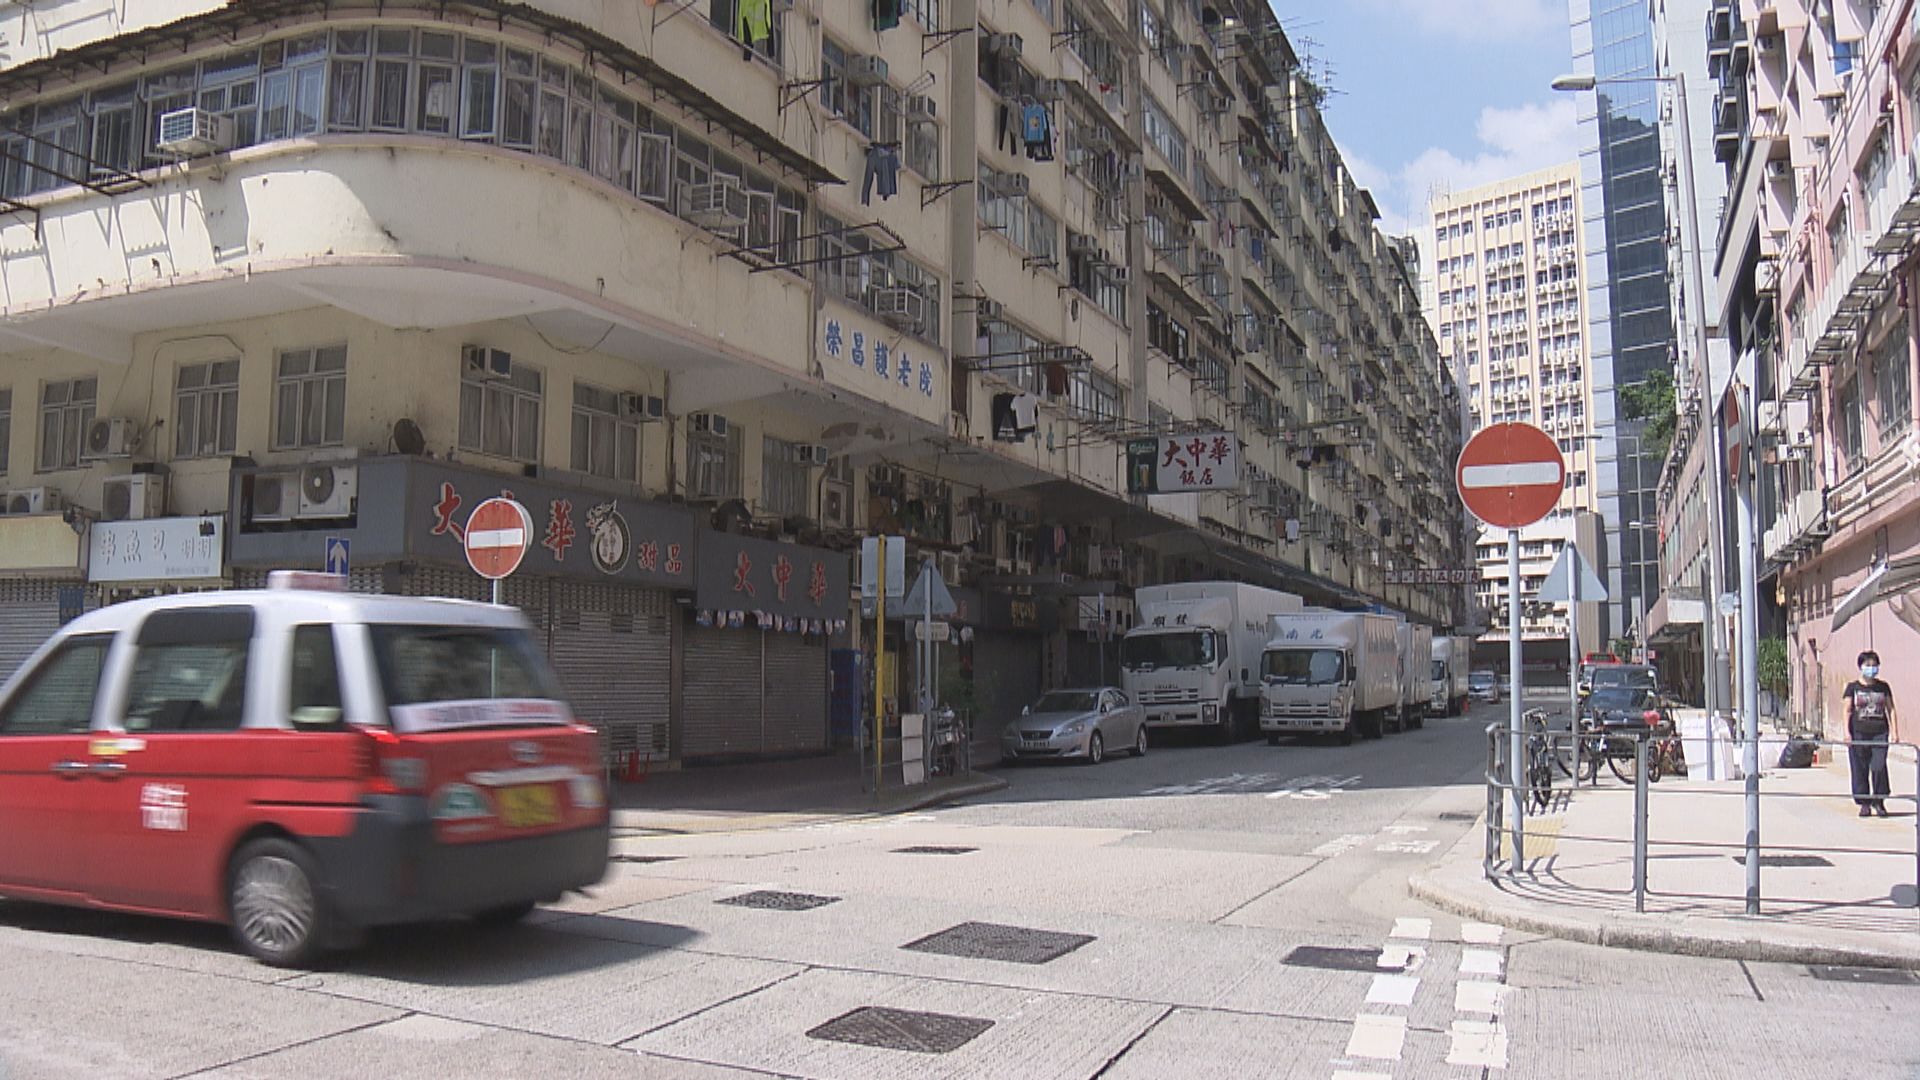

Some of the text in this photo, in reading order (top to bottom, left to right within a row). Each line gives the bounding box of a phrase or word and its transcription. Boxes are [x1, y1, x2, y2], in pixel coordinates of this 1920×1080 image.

[826, 319, 932, 397] 榮昌護老院
[1162, 436, 1231, 467] 大中華
[1179, 467, 1213, 485] 飯店
[430, 482, 576, 561] 大華
[734, 550, 827, 607] 大中華
